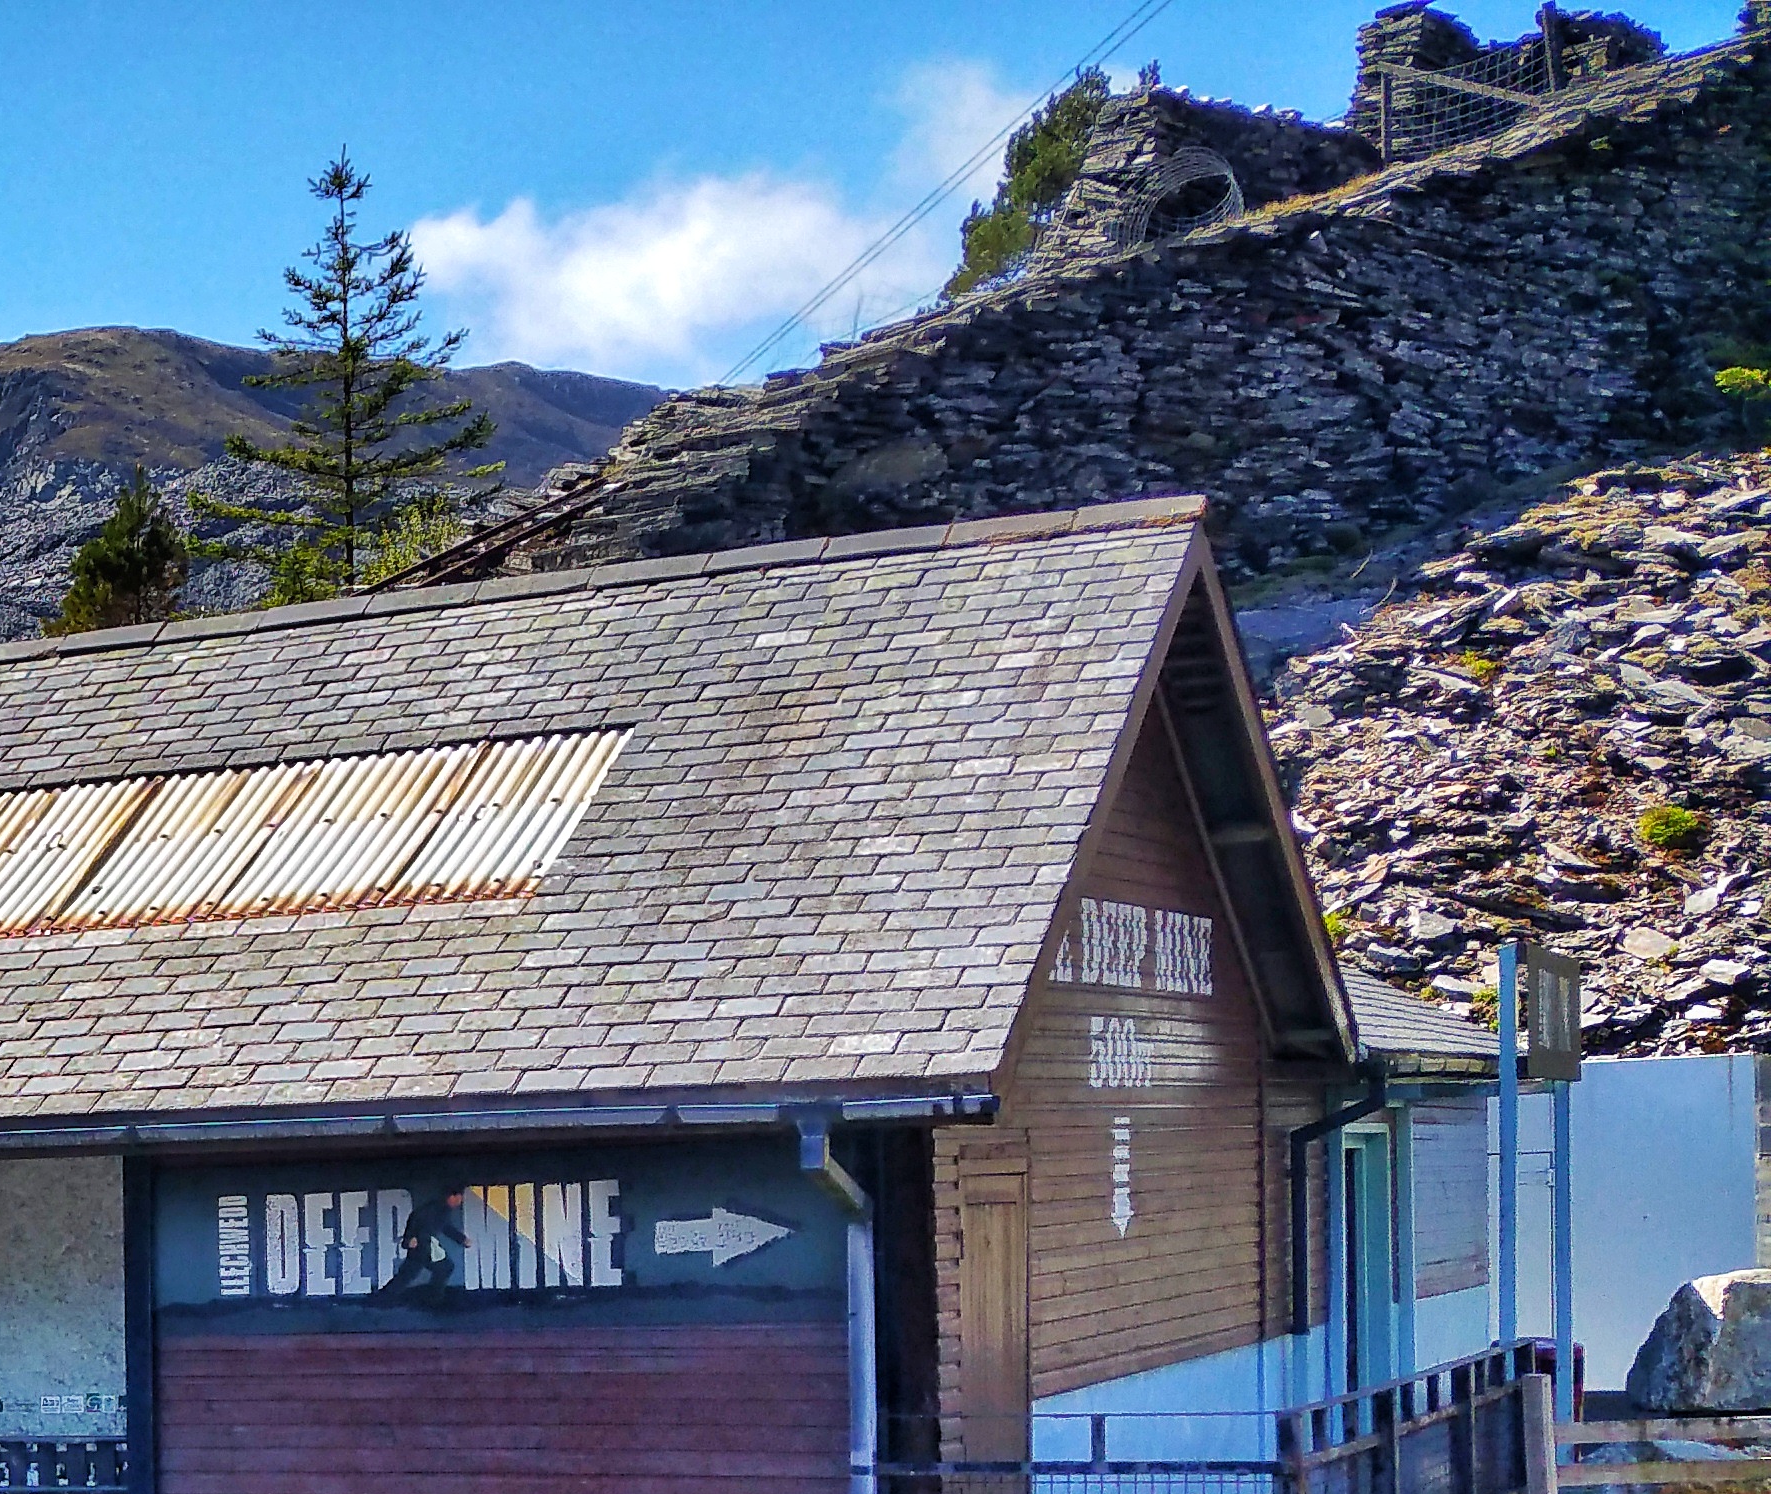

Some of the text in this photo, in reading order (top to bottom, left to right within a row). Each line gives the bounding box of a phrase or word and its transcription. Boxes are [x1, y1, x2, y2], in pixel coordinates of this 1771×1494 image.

[1080, 896, 1149, 989] DEEP
[1154, 909, 1213, 997] MINE
[218, 1194, 252, 1296] LLECHWEDD
[265, 1178, 623, 1297] DEEP MINE
